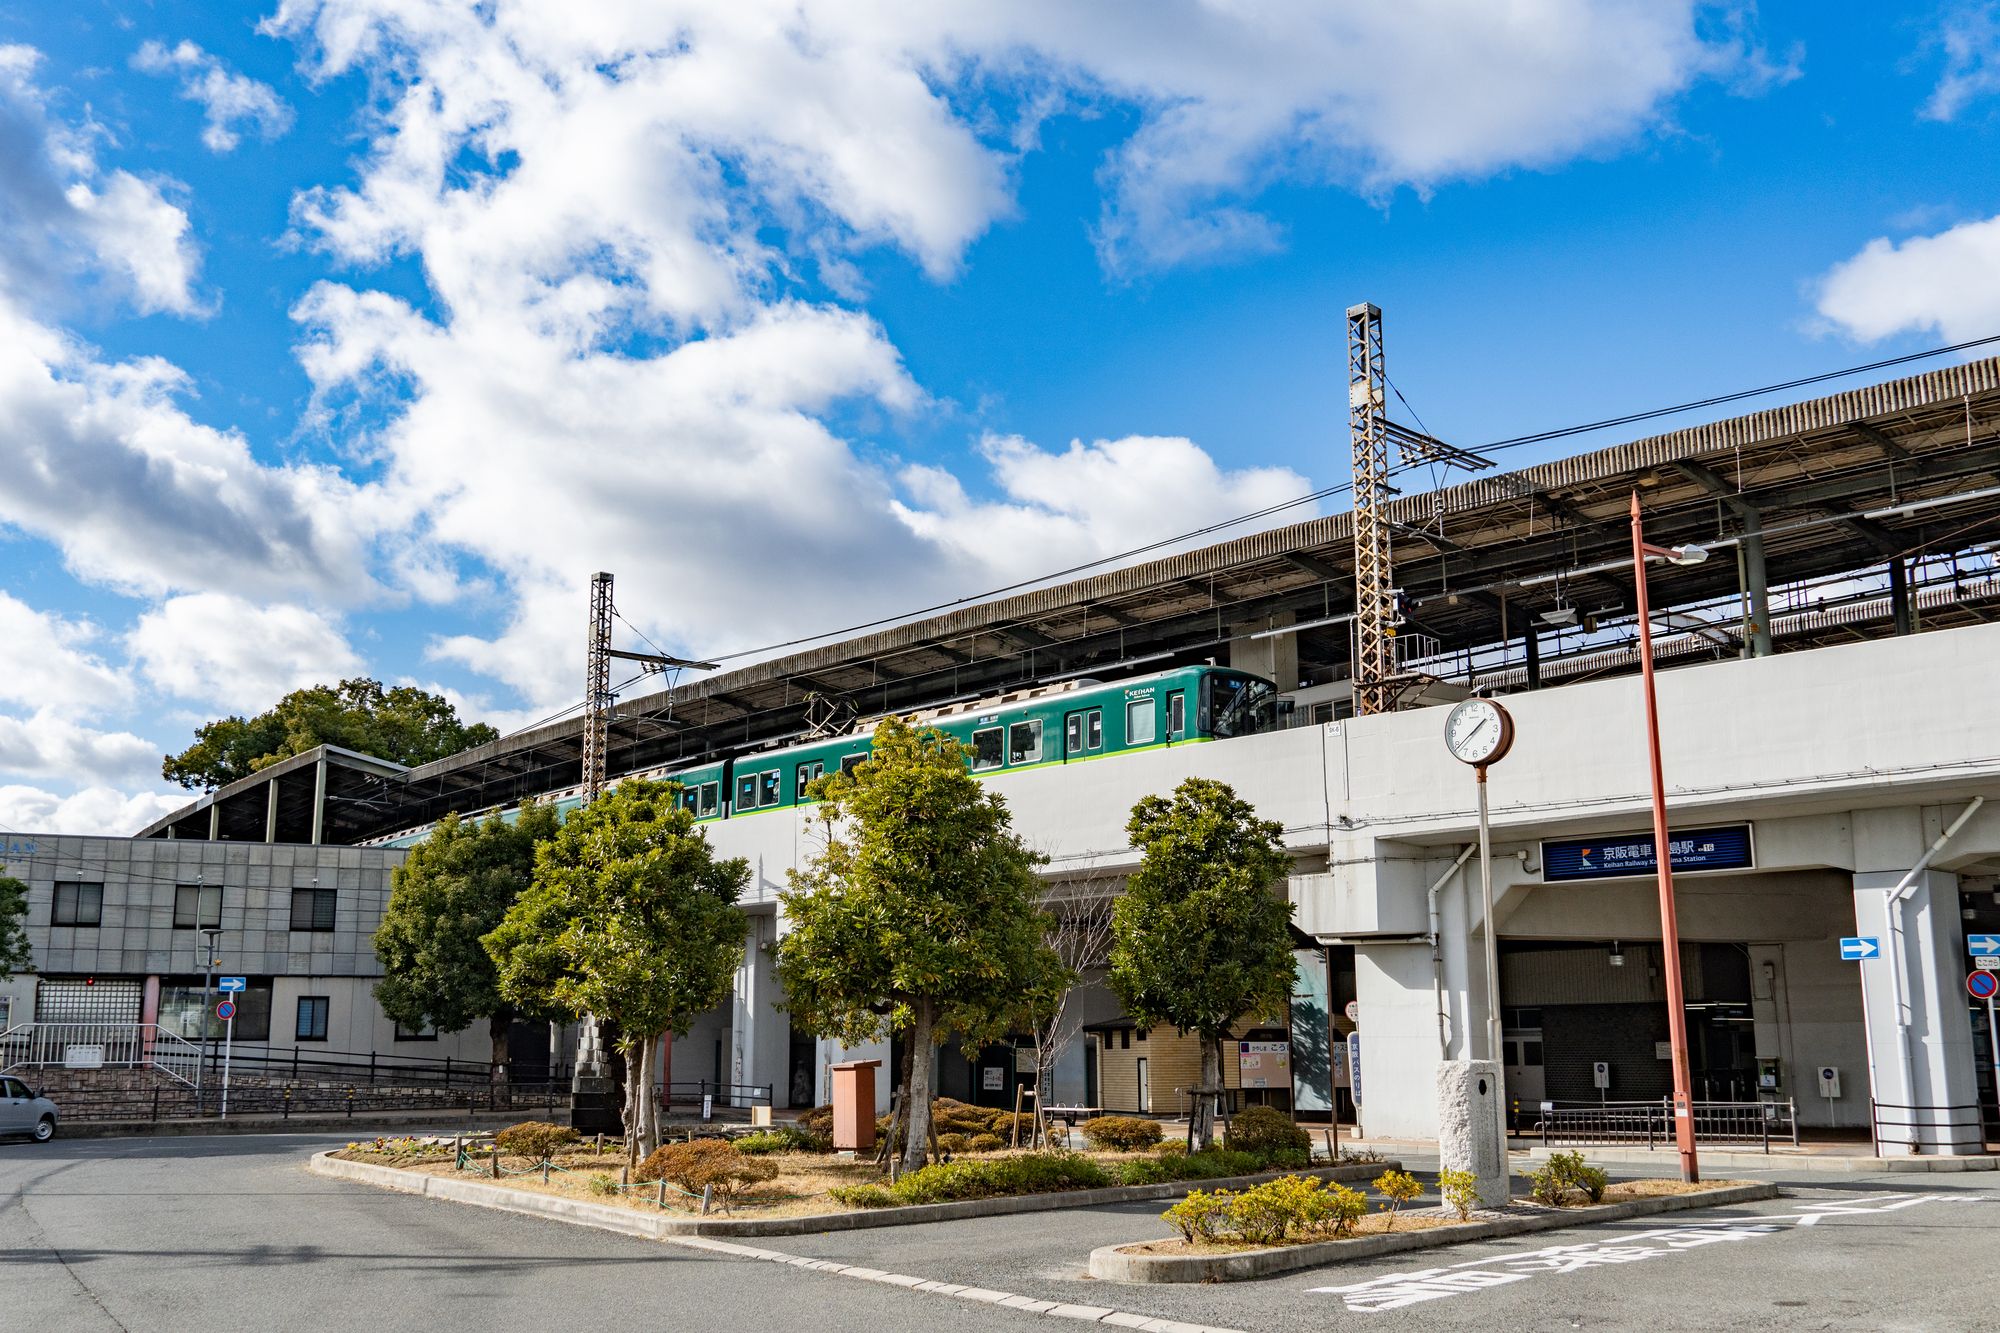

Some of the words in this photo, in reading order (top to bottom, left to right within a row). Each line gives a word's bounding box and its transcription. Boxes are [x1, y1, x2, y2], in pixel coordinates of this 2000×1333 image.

[1471, 704, 1478, 712] 12
[1489, 713, 1495, 721] 2
[1493, 725, 1498, 733] 3
[1463, 748, 1468, 756] 7
[1472, 750, 1478, 758] 6
[1483, 746, 1488, 754] 5
[1603, 844, 1652, 860] 京阪電車
